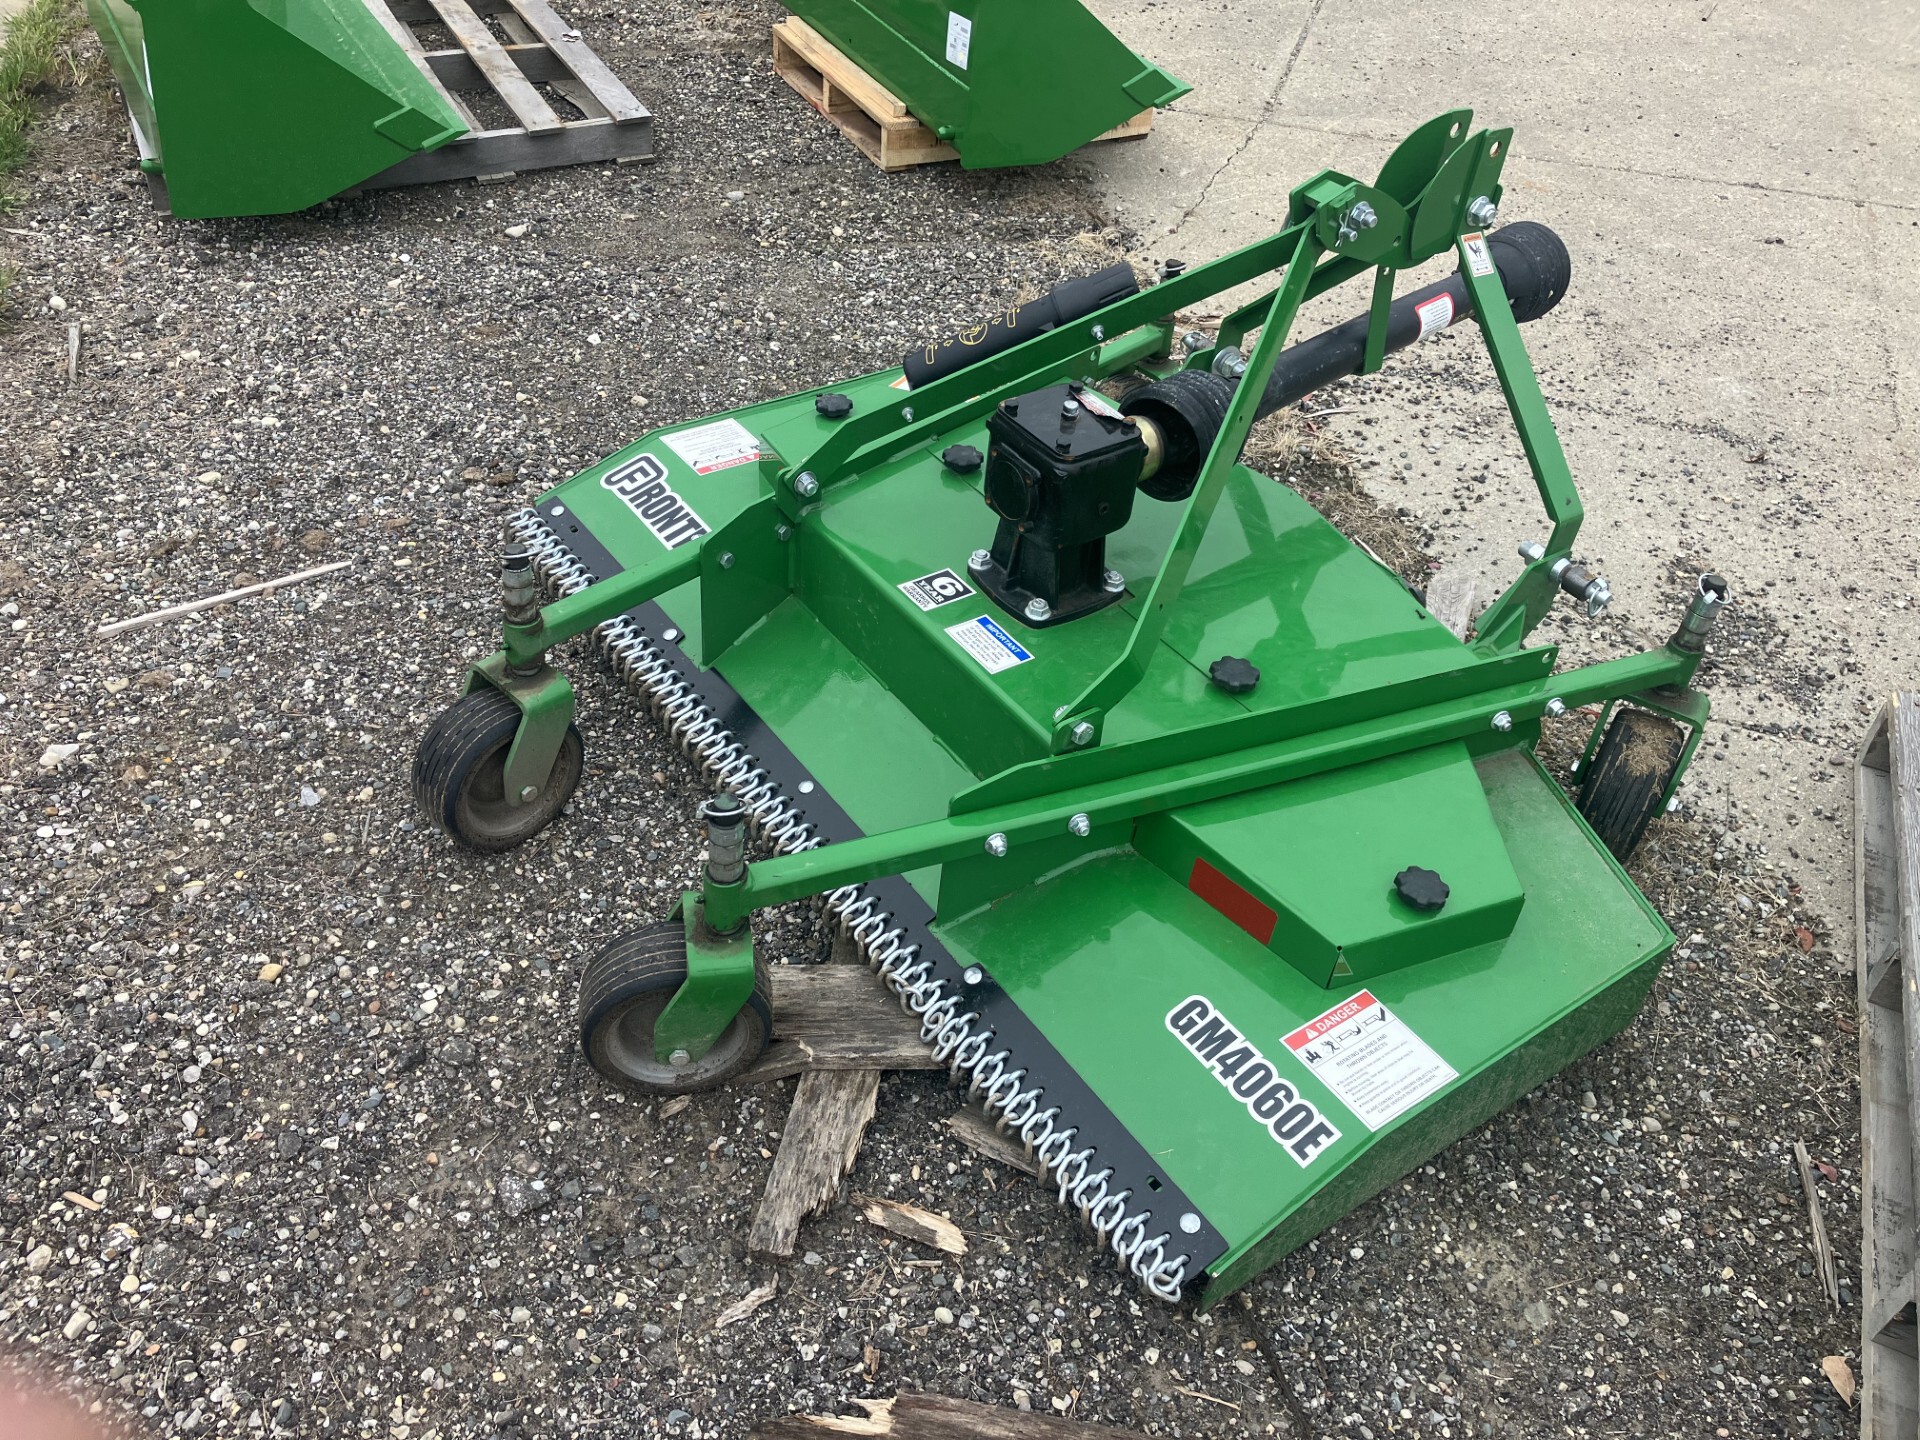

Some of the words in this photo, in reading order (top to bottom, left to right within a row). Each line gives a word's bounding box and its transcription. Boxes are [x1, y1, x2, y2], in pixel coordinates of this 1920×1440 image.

[901, 585, 929, 608] WARRANTY
[917, 580, 945, 602] YEAR
[931, 576, 965, 597] 6
[985, 623, 1021, 653] IMPORTANT
[1314, 1001, 1361, 1032] DANGER
[1335, 1050, 1360, 1067] ROTATING
[1169, 999, 1335, 1162] GM4060E
